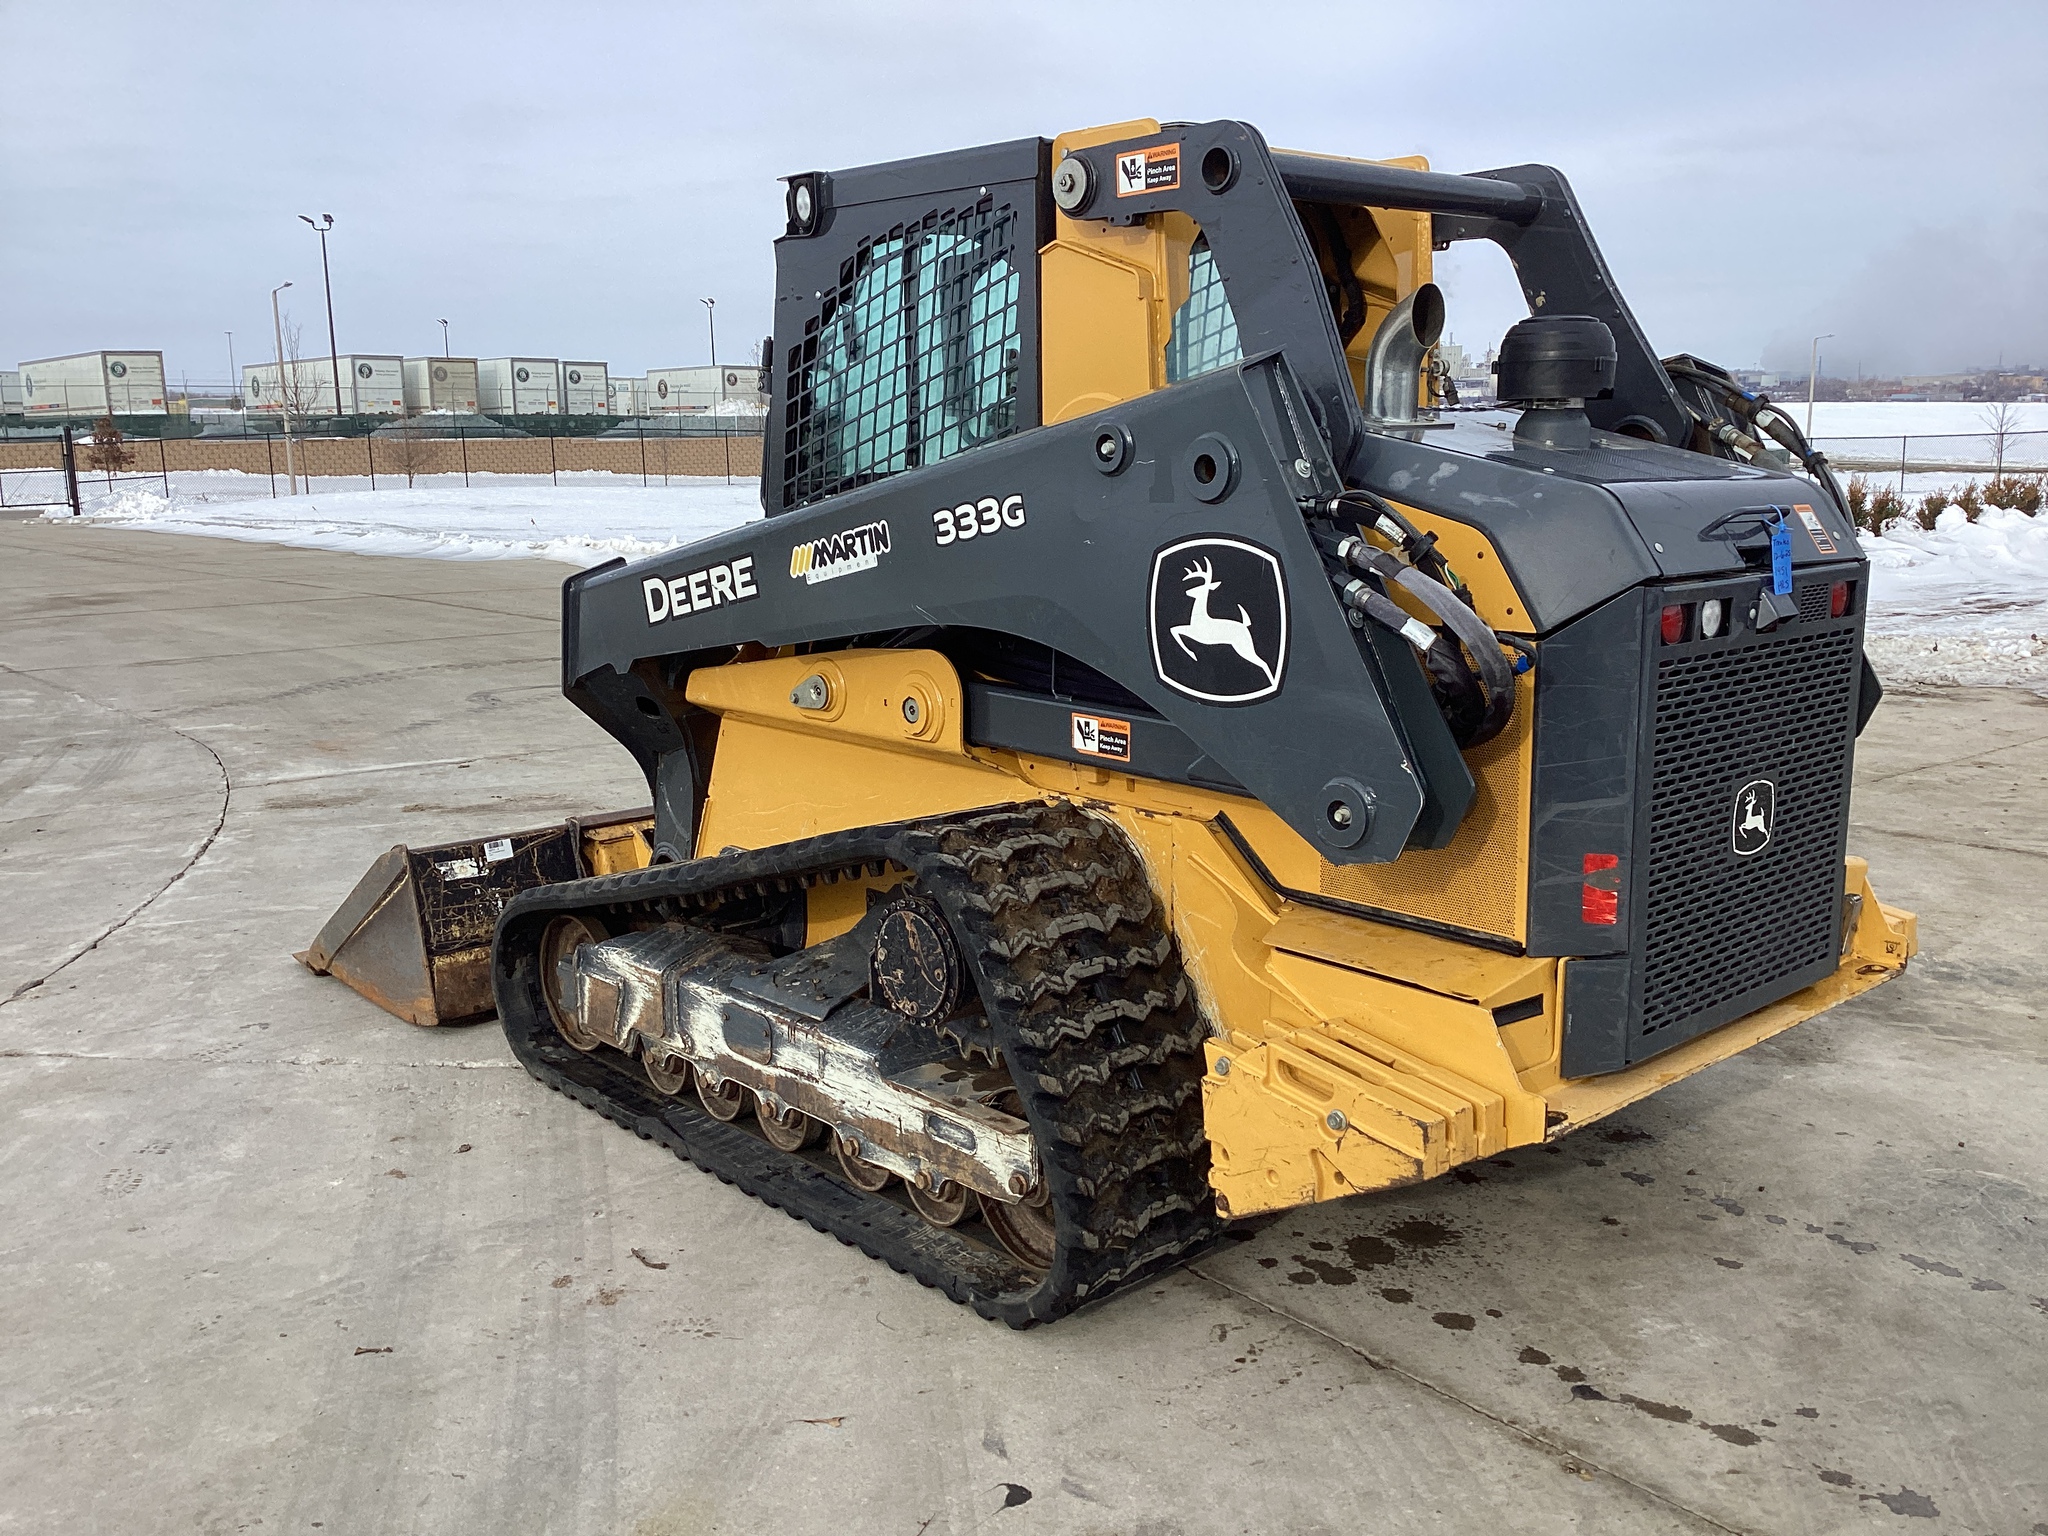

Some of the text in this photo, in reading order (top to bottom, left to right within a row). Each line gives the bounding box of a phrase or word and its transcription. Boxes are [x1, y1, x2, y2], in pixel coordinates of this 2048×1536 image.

[1151, 148, 1177, 158] WARNING
[1146, 164, 1176, 175] Pinch Area
[1146, 174, 1172, 184] Keep Away
[933, 495, 1026, 546] 333G
[811, 522, 889, 569] MARTIN
[806, 558, 878, 582] Equipment
[643, 555, 758, 624] DEERE
[1099, 734, 1127, 745] Pinch Area
[1111, 744, 1123, 753] Away
